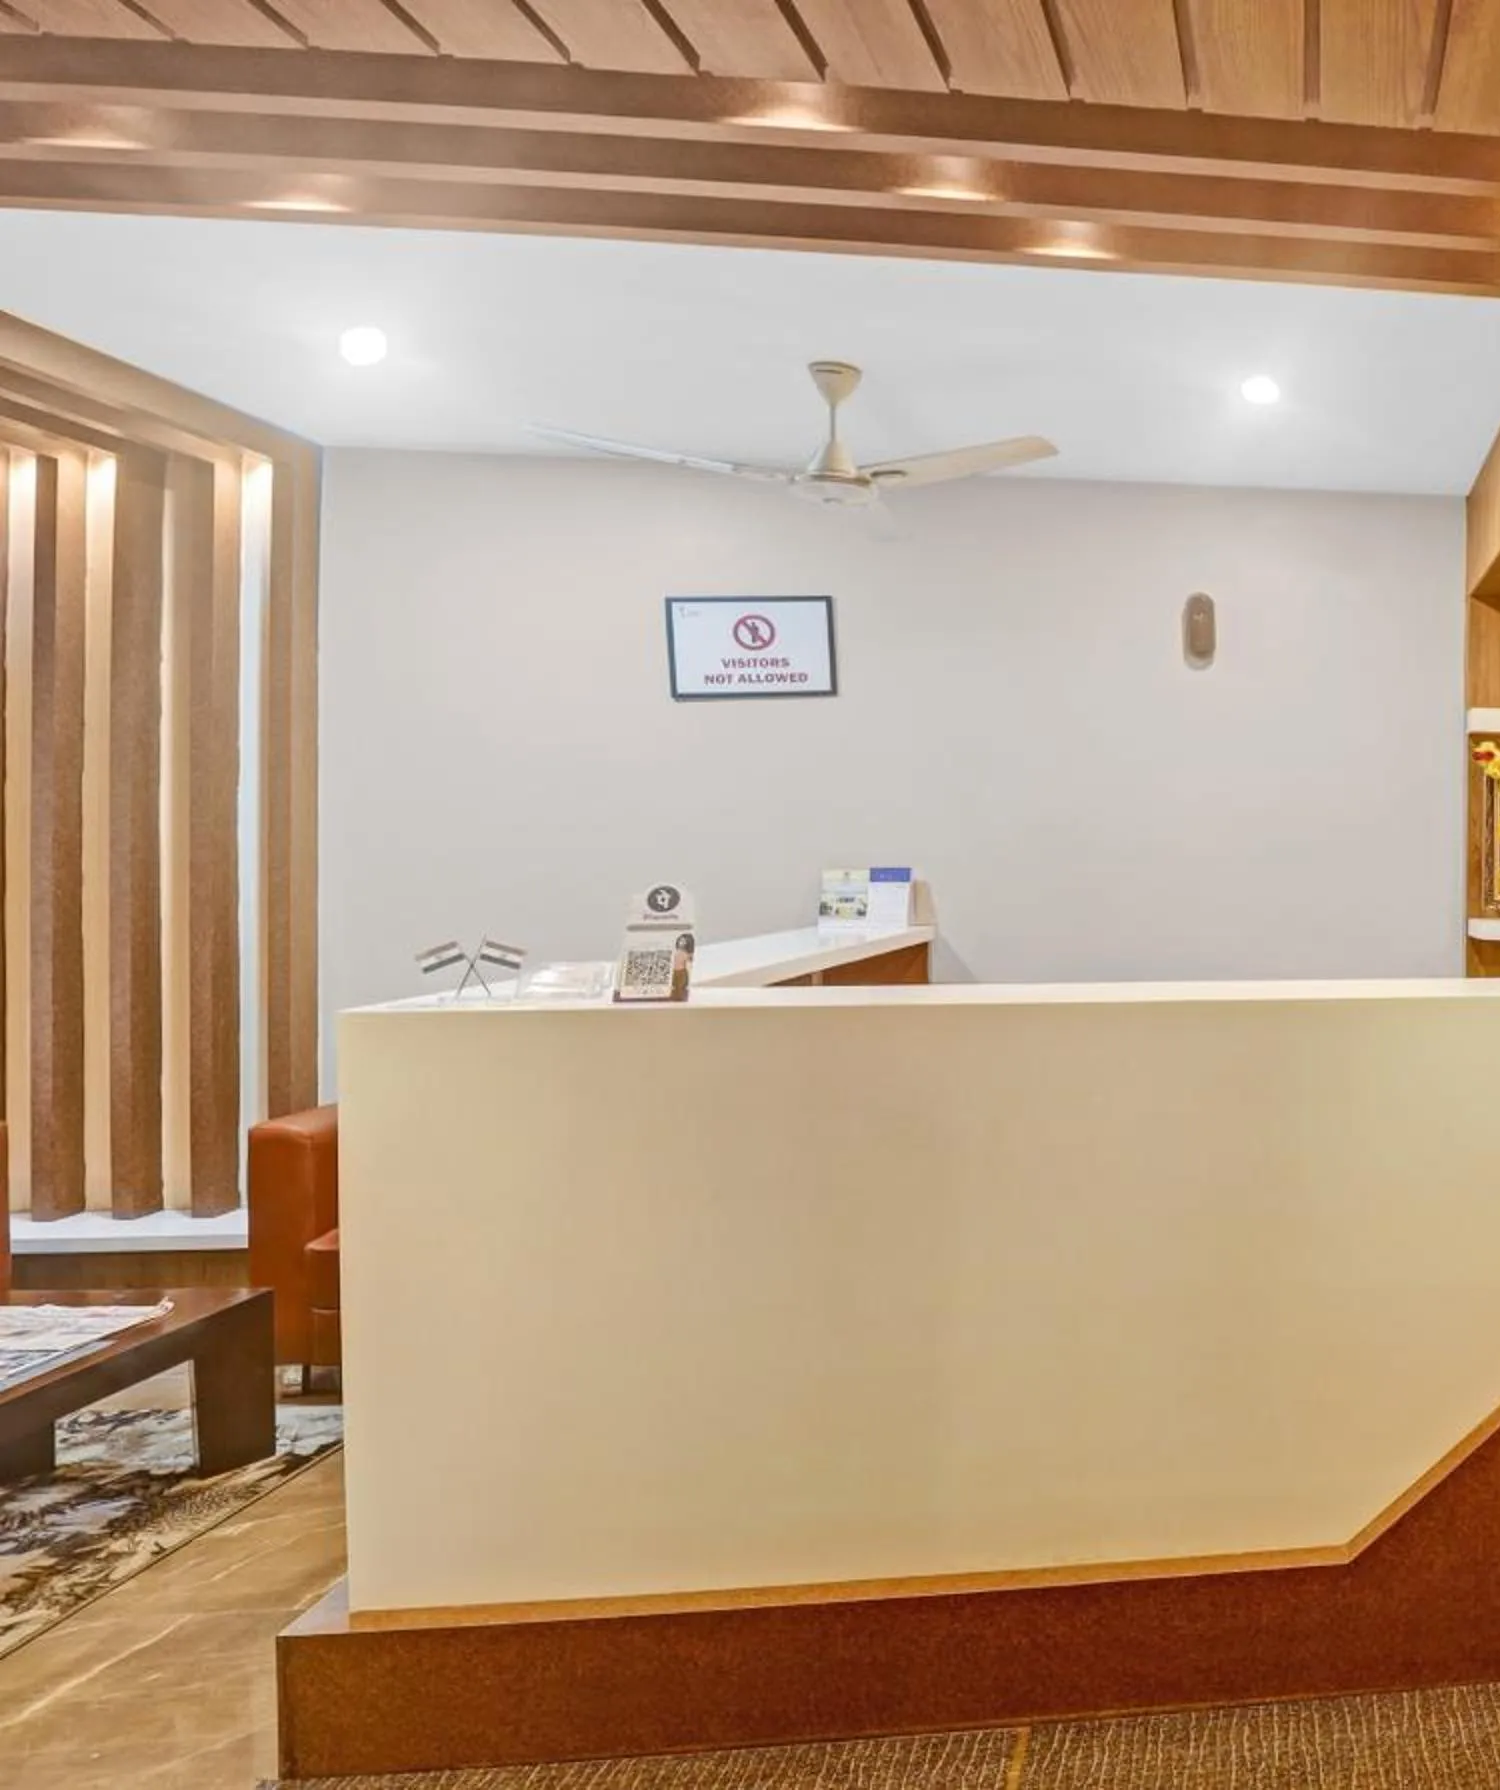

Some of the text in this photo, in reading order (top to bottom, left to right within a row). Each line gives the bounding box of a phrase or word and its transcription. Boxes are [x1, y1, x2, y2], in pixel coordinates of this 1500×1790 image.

[720, 657, 791, 669] VISITORS
[704, 672, 809, 685] NOT ALLOWED
